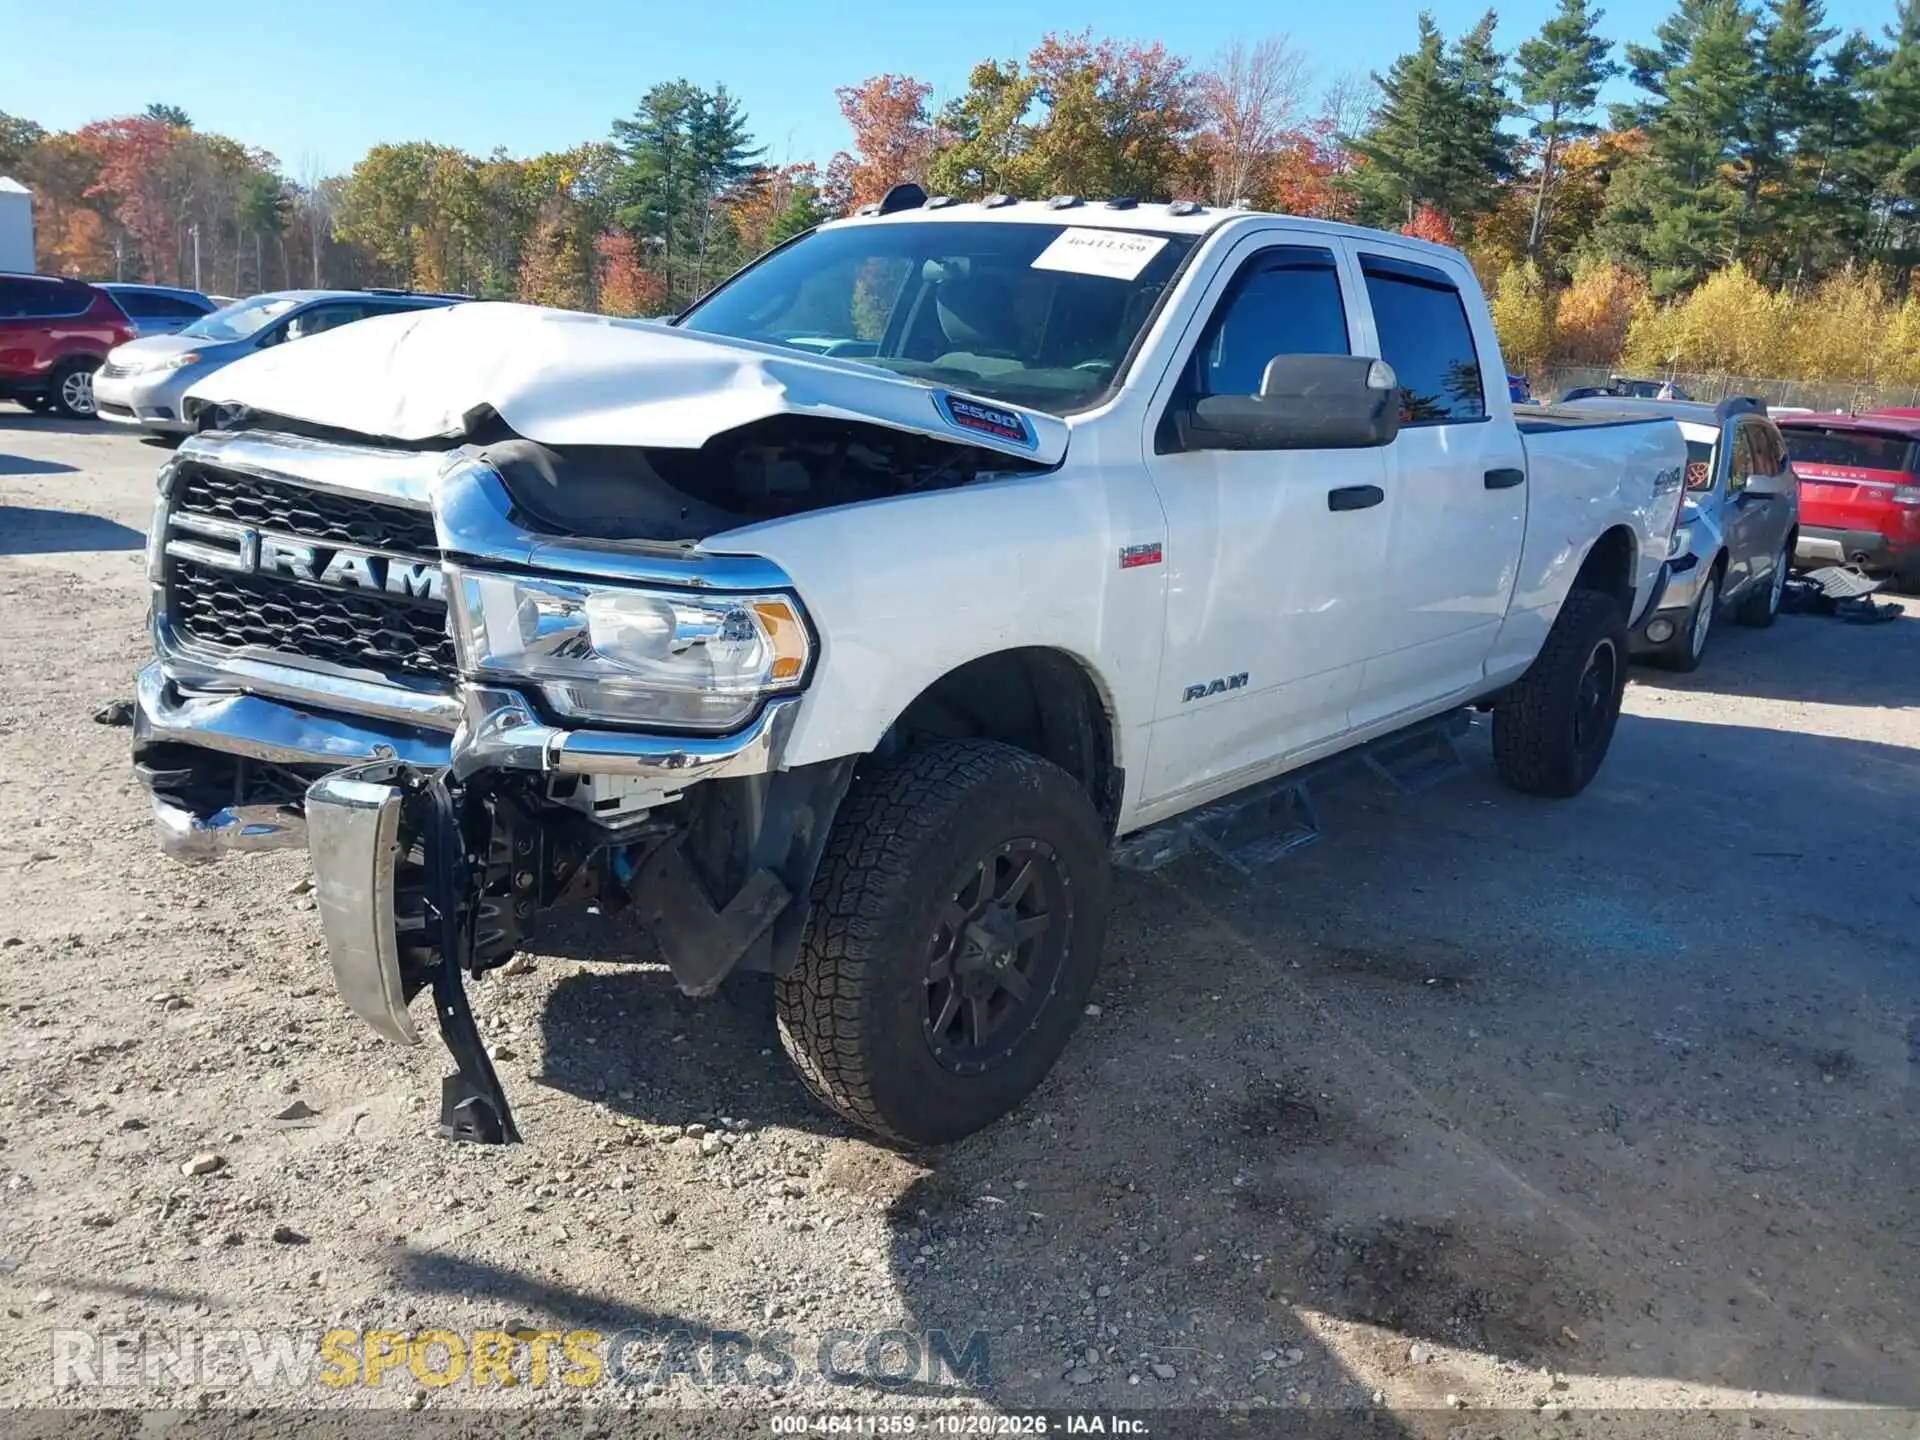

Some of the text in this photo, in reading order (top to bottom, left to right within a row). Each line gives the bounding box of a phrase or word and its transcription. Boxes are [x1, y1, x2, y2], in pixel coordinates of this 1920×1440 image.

[952, 400, 1018, 429] 2500
[259, 535, 444, 602] RAM
[1182, 671, 1249, 703] RAM
